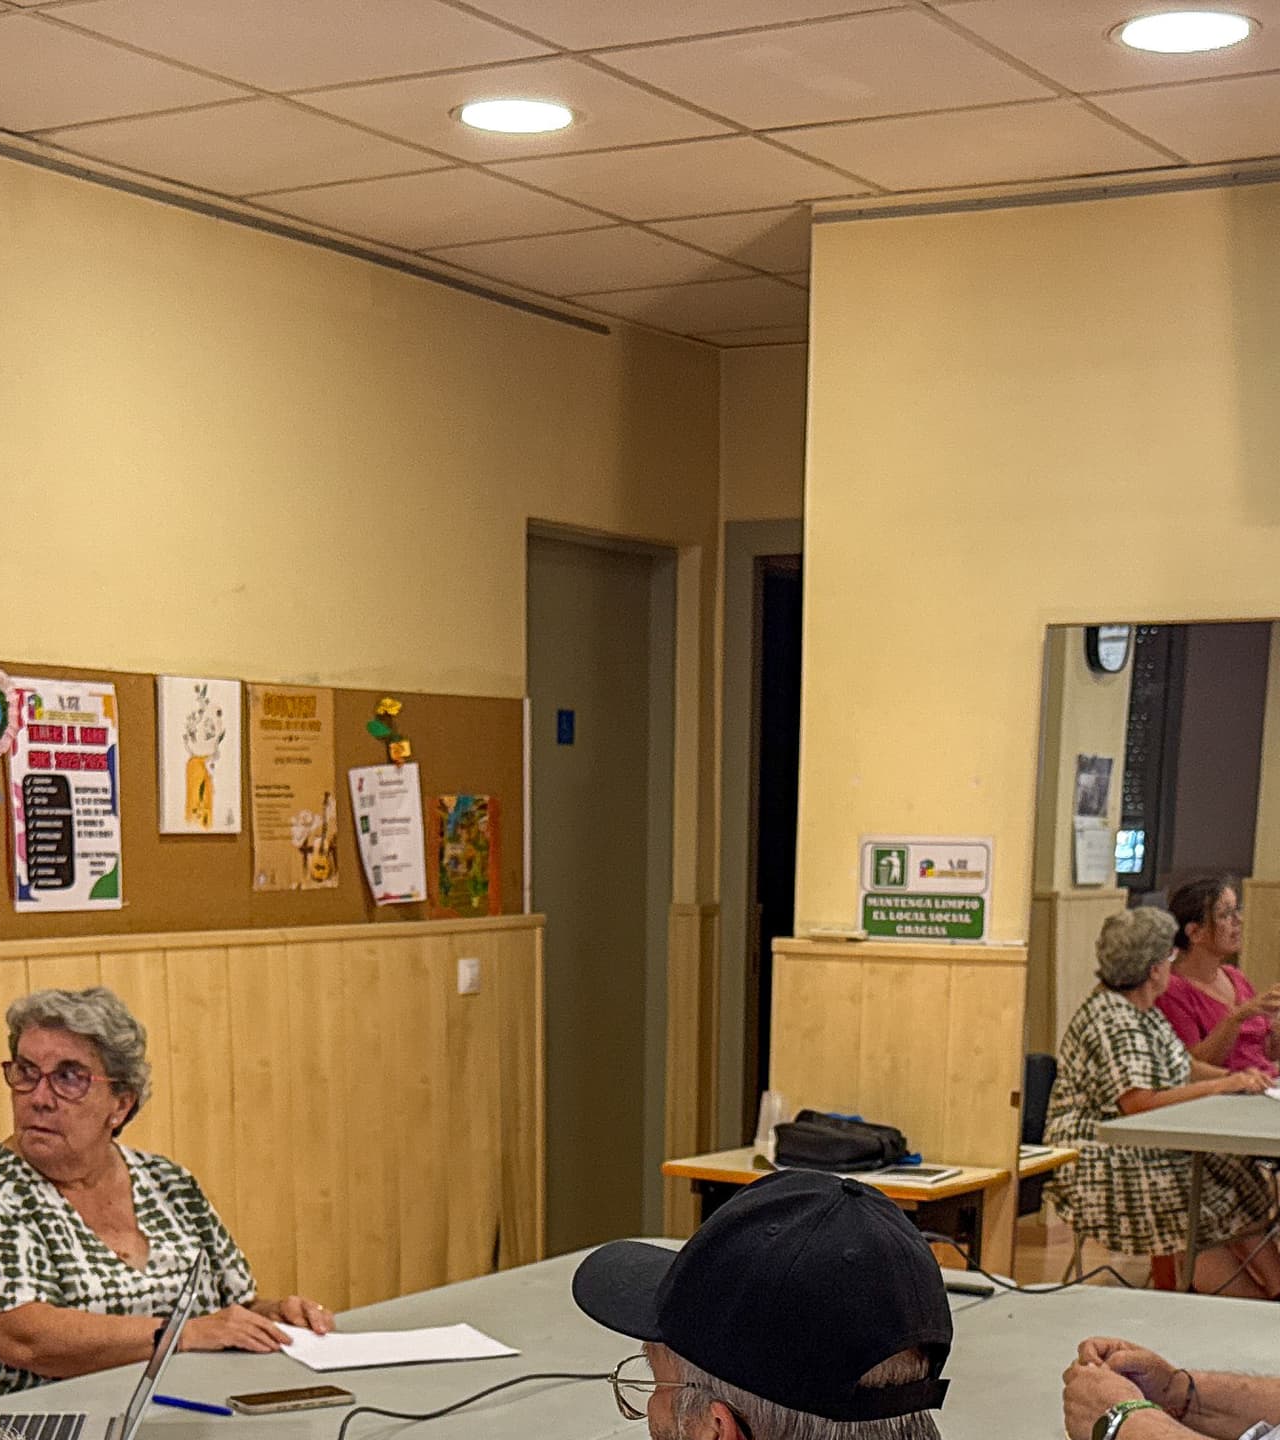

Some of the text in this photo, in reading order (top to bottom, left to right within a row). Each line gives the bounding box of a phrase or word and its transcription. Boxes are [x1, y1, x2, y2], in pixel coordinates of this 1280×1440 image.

[866, 897, 980, 911] MANTENGA LIMPIO
[872, 911, 972, 924] EL LOCAL SOCIAL
[896, 925, 948, 936] GRACIAS
